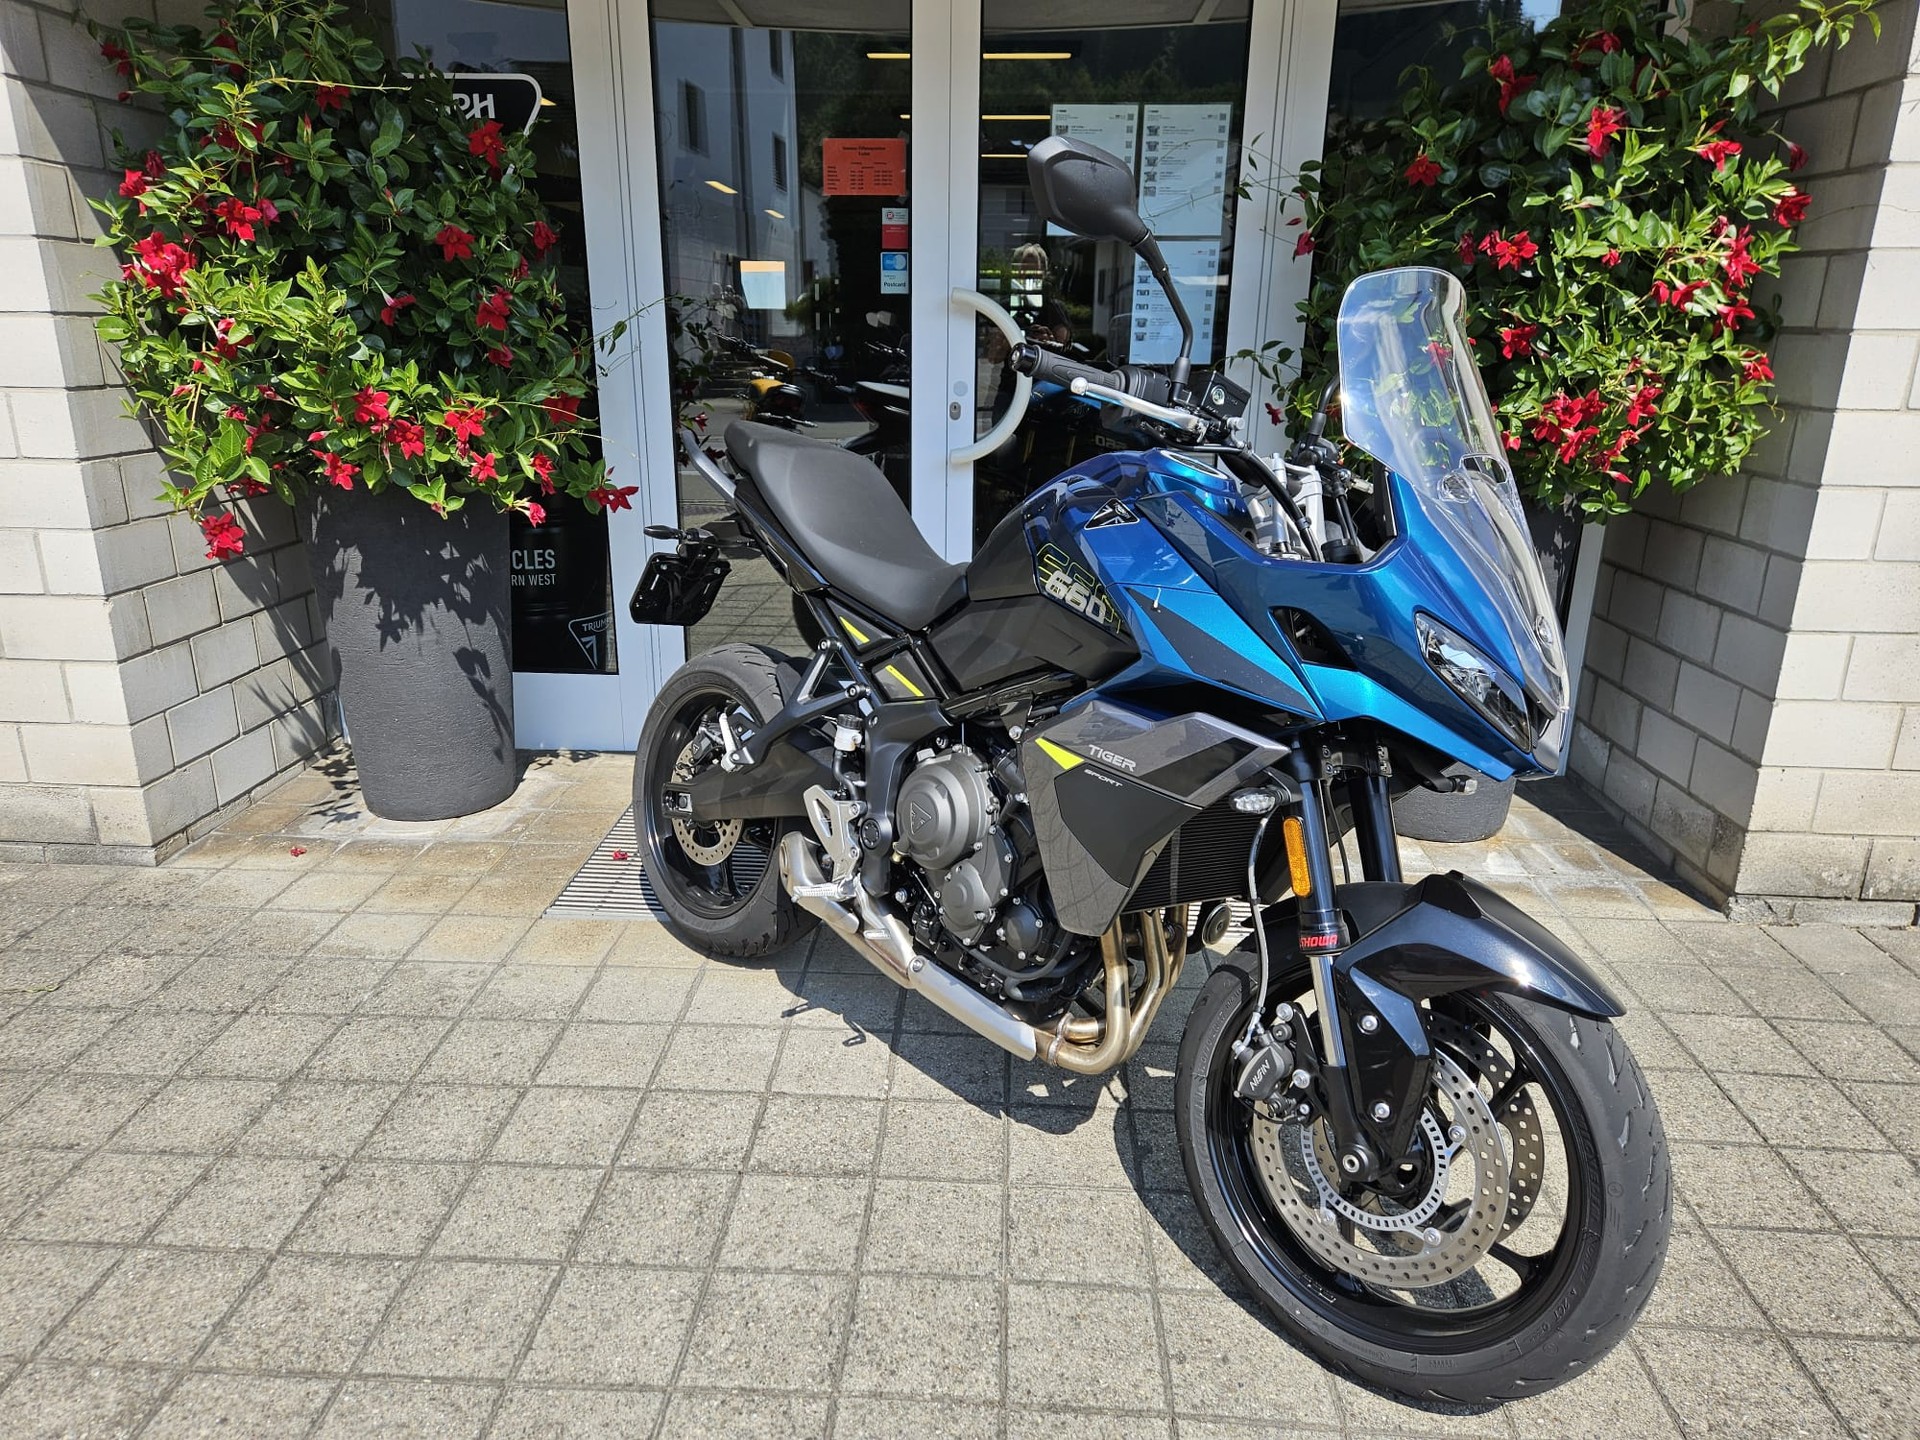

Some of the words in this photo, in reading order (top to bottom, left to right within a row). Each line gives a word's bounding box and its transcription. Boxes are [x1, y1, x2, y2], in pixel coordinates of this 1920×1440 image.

[452, 93, 496, 119] PH
[511, 548, 556, 570] CLES
[511, 574, 526, 586] RN
[528, 573, 557, 586] WEST
[1045, 570, 1106, 625] 660
[581, 617, 611, 632] TRIUM
[1088, 744, 1137, 773] TIGER
[1083, 768, 1123, 787] SPORT
